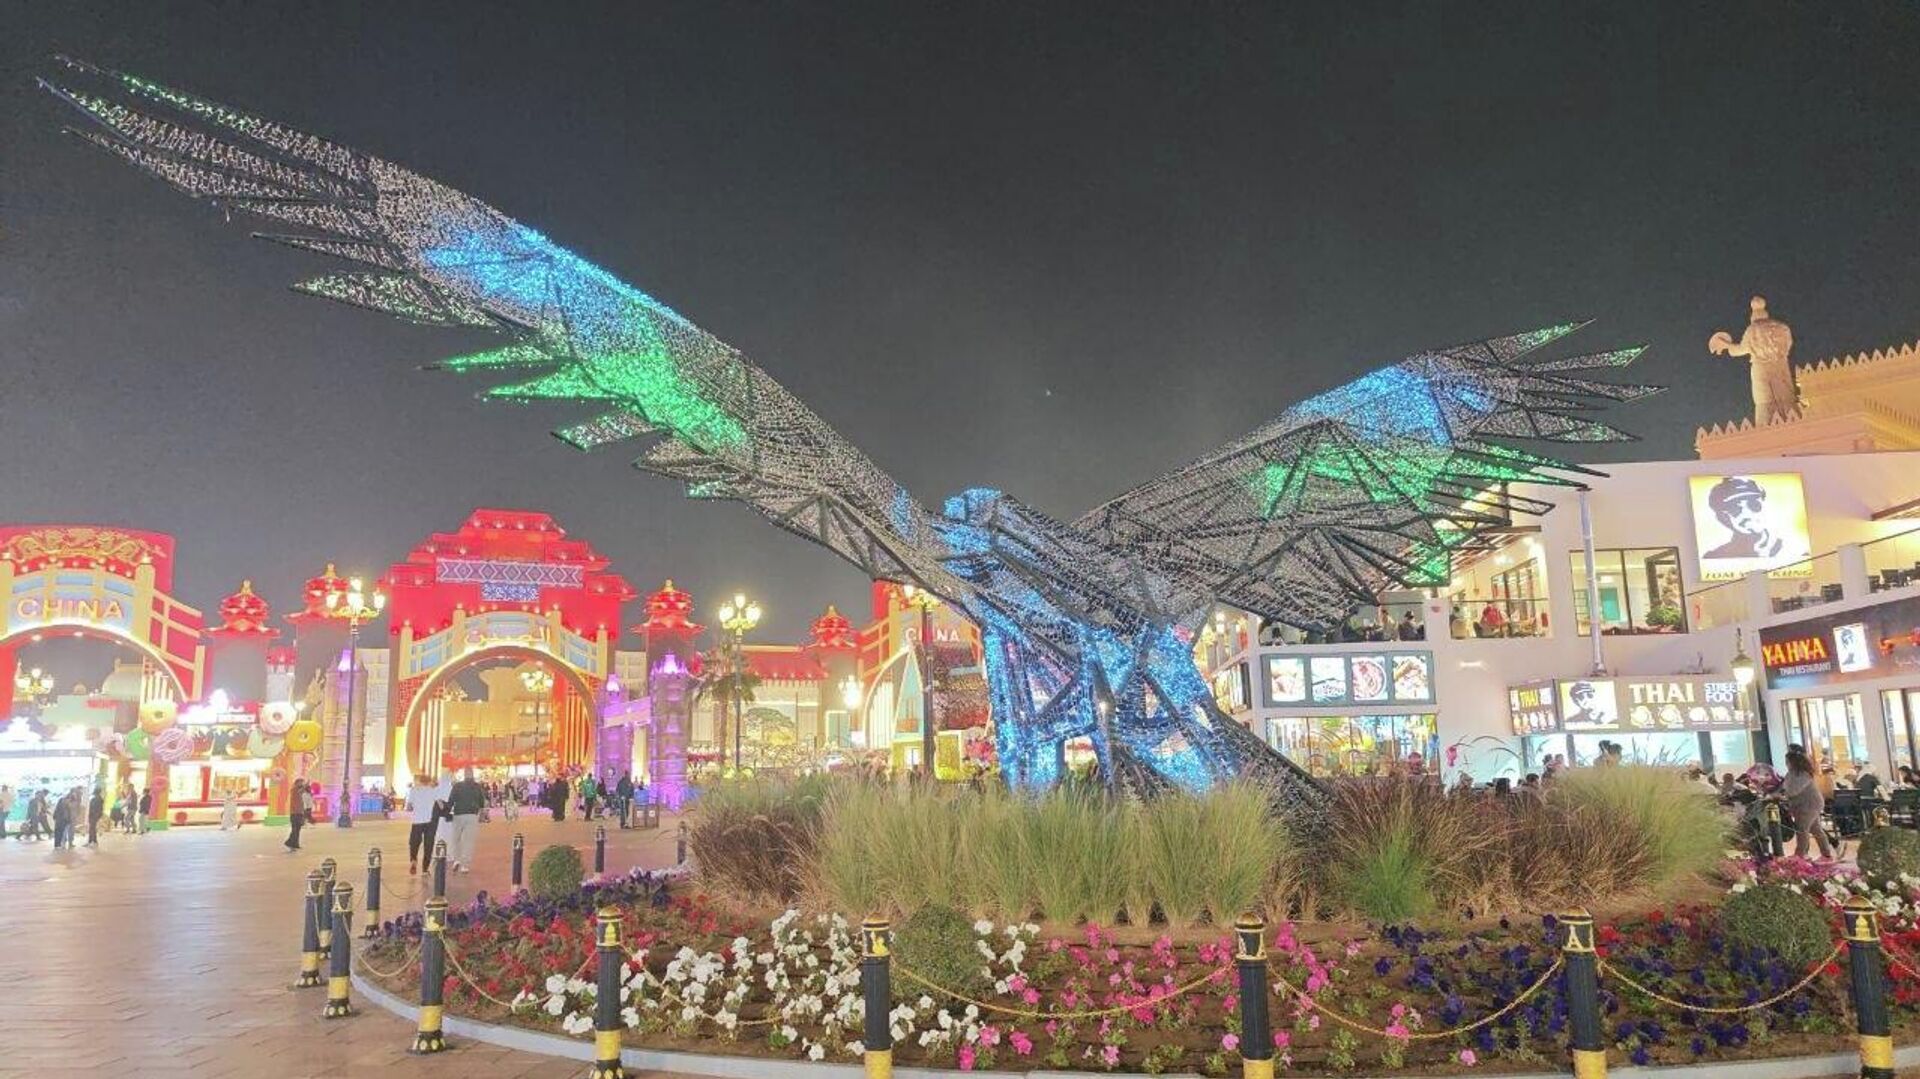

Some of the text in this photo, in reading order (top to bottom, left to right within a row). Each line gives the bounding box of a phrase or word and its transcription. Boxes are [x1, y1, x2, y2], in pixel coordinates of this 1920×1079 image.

[17, 598, 124, 620] CHINA
[906, 627, 960, 641] CINA
[1762, 637, 1828, 666] YAHYA
[1628, 682, 1695, 703] THAI
[1704, 682, 1740, 694] STREE
[1705, 692, 1735, 702] FOO
